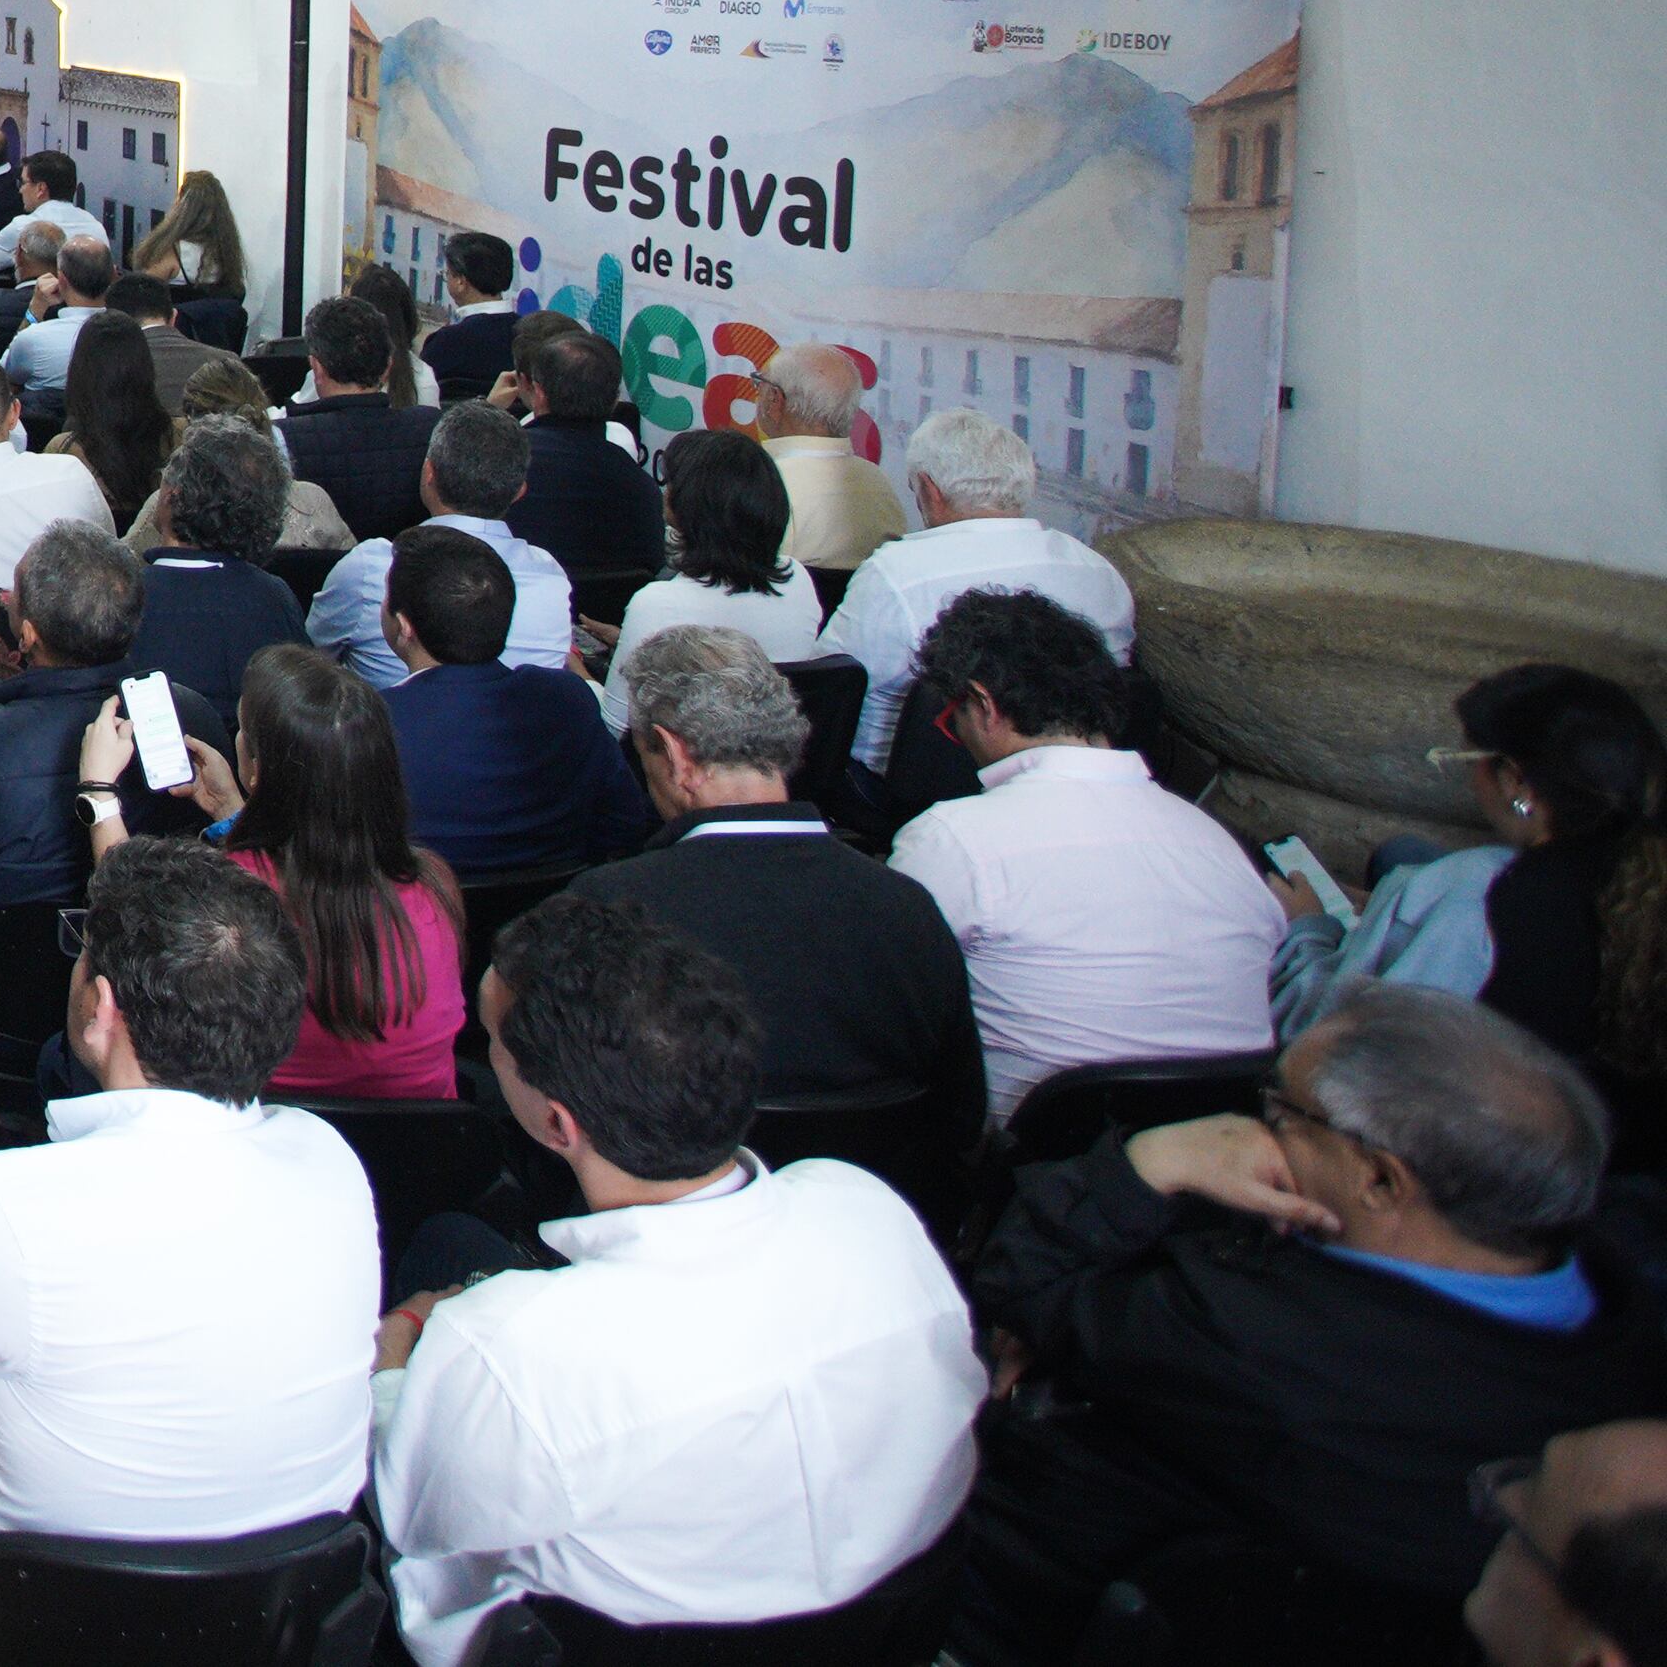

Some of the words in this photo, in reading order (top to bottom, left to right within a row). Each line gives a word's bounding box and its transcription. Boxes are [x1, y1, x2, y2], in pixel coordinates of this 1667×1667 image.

[665, 7, 689, 15] GROUP
[719, 0, 761, 15] DIAGEO
[691, 34, 720, 46] AMOR
[1004, 33, 1044, 46] Boyacá
[1103, 32, 1171, 51] IDEBOY
[690, 46, 721, 55] PERFECTO
[543, 127, 855, 253] Festival
[631, 236, 673, 278] de
[684, 243, 734, 290] las
